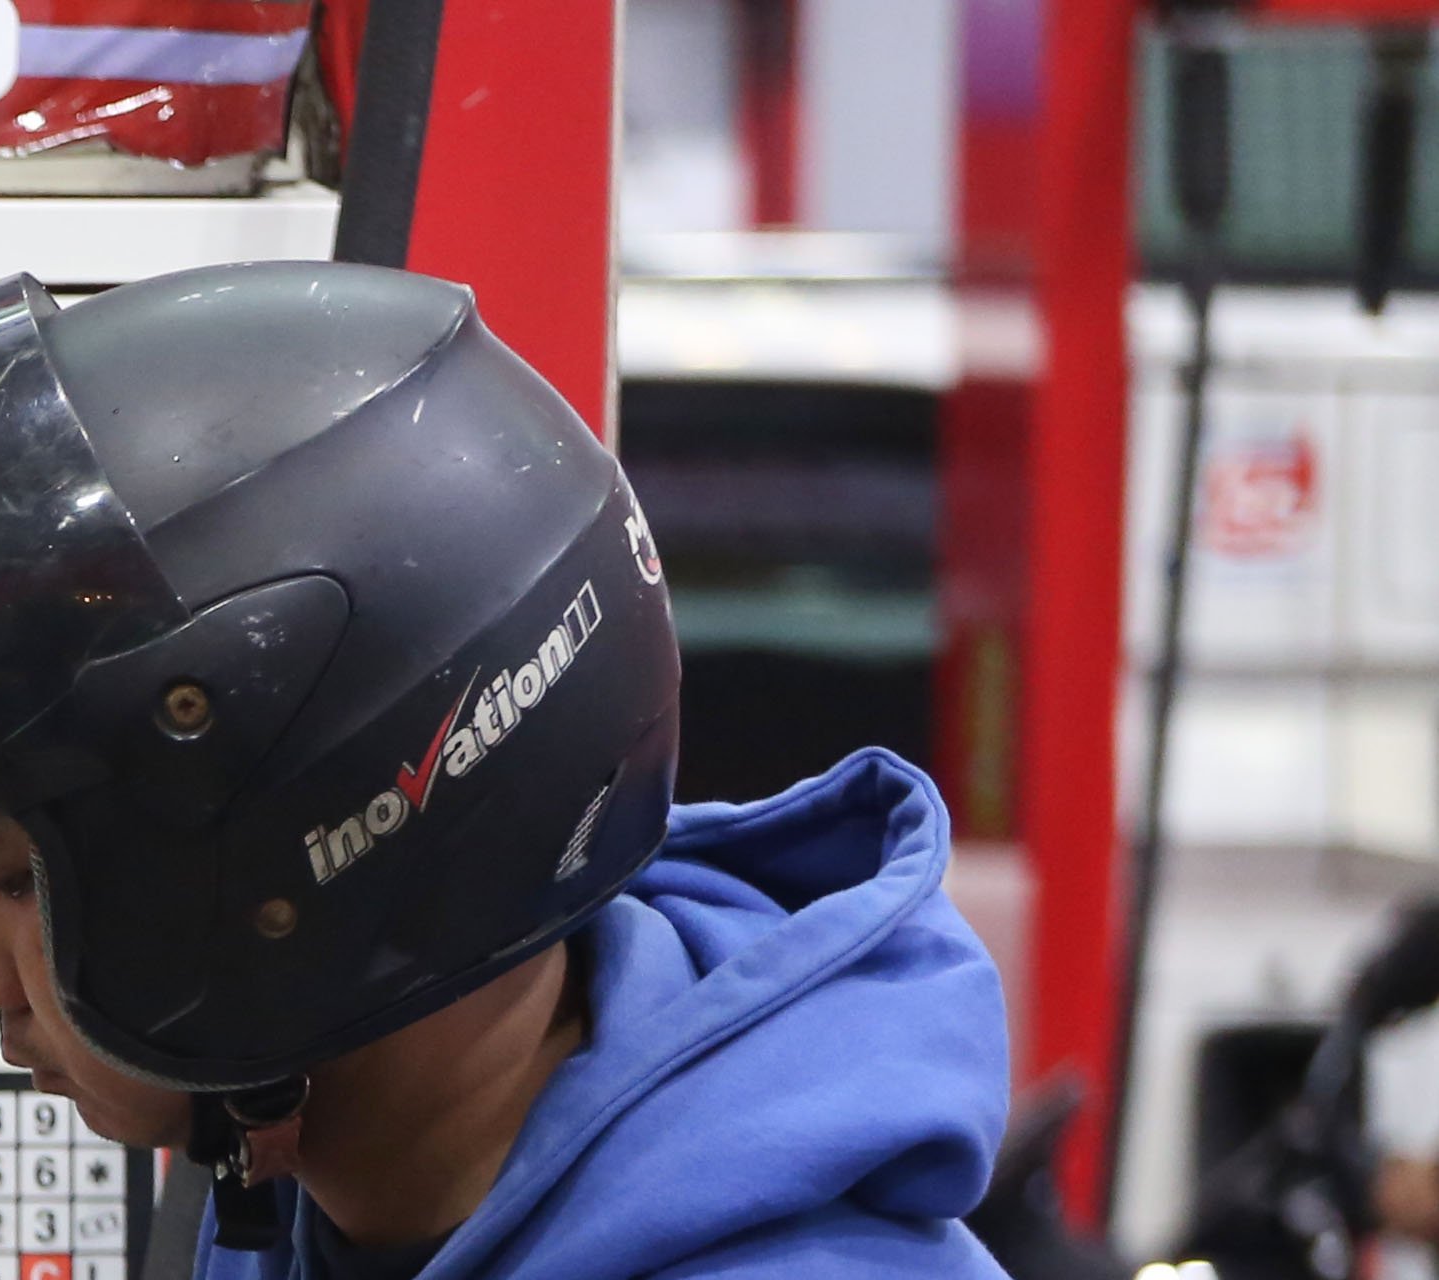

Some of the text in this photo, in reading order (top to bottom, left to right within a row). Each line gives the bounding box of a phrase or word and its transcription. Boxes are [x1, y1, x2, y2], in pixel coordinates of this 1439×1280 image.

[35, 1102, 56, 1135] 9
[35, 1156, 56, 1189] 6
[35, 1209, 57, 1242] 3
